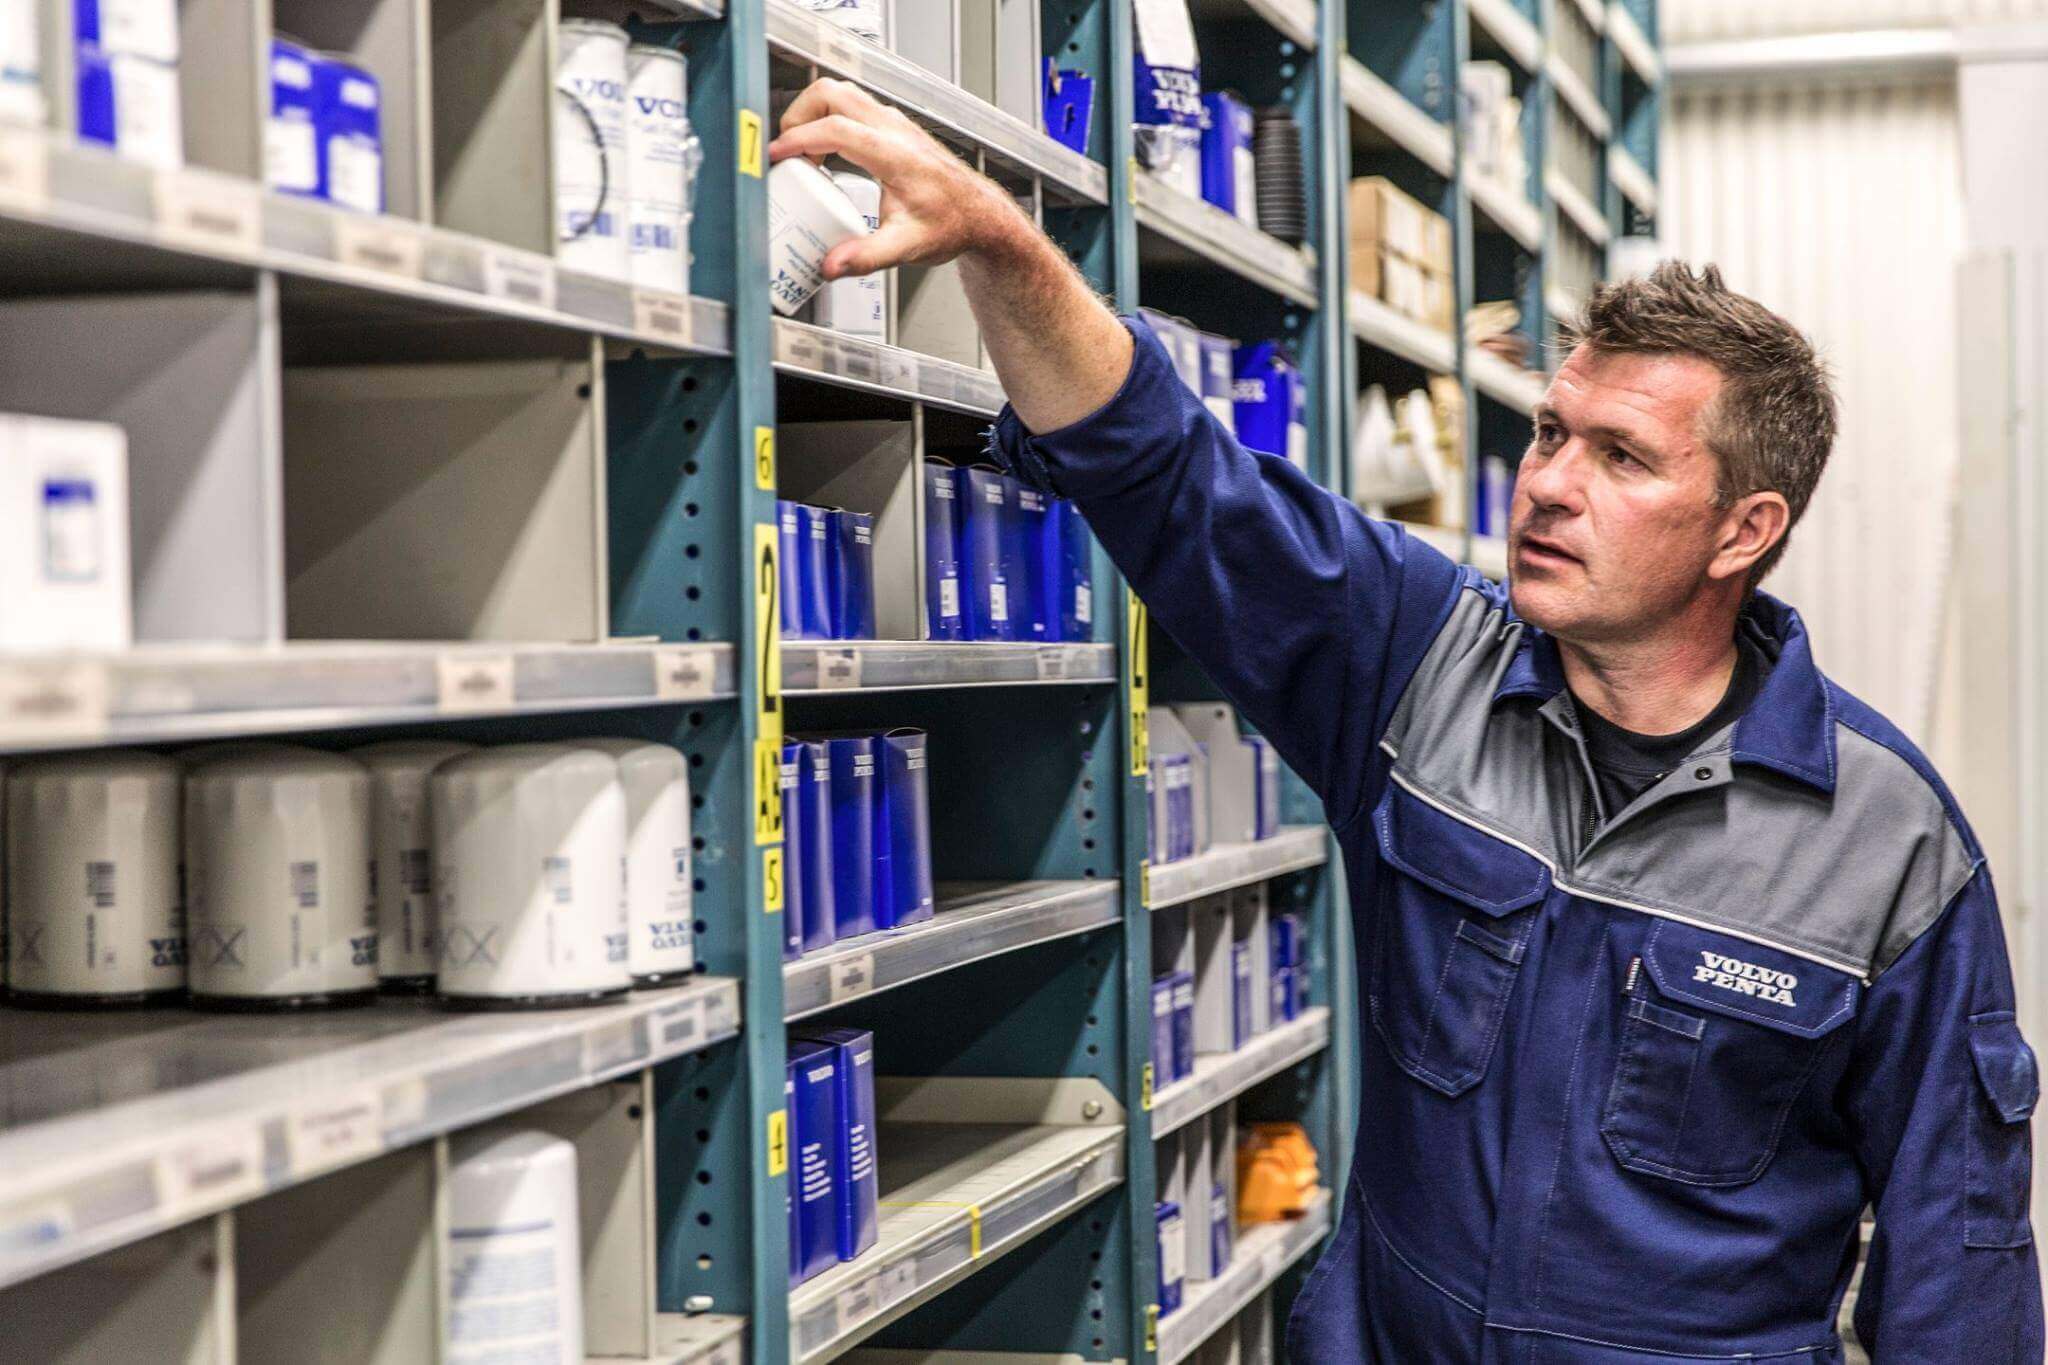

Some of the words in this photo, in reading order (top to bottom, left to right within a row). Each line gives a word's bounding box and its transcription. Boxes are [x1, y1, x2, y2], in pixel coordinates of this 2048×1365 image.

[747, 121, 759, 165] 7
[759, 437, 771, 480] 6
[761, 543, 776, 713] 2
[758, 750, 781, 832] AB
[768, 858, 779, 902] 5
[1692, 965, 1797, 1007] PENTA
[1700, 950, 1798, 990] VOLVO
[772, 1122, 784, 1166] 4
